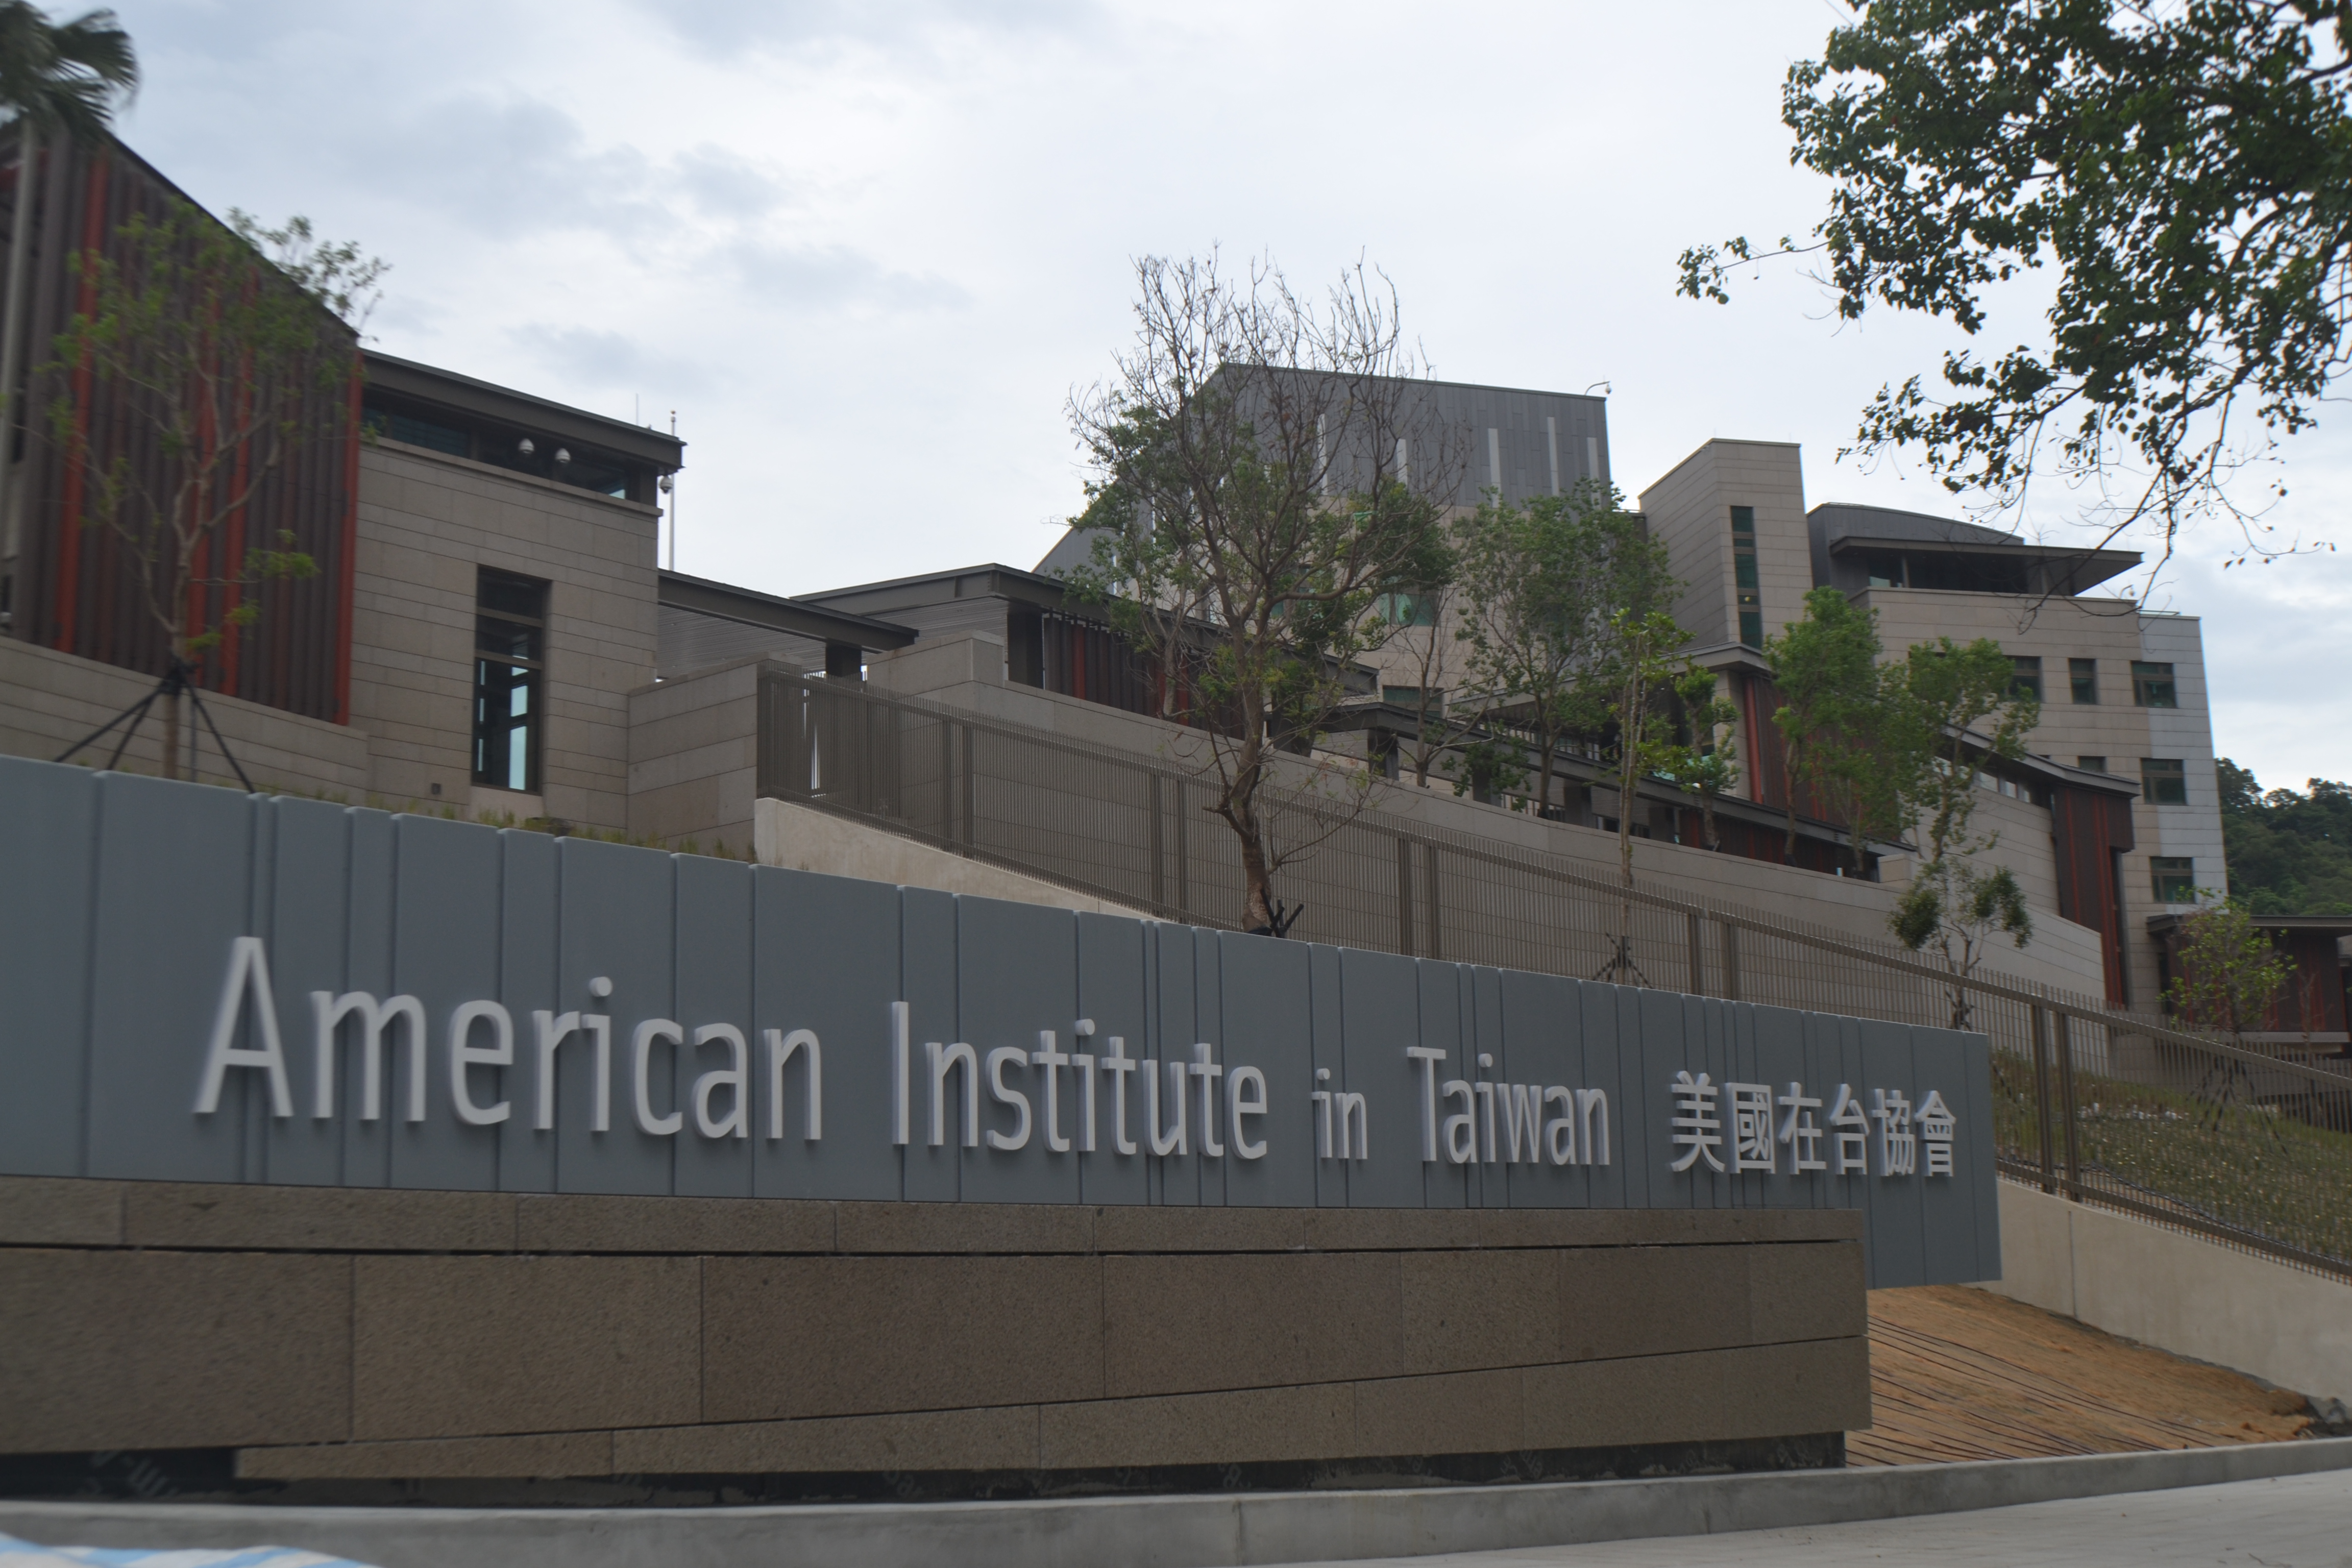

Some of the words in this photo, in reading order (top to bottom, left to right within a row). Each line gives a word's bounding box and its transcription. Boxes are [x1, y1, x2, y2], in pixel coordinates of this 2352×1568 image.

[192, 936, 822, 1140] American
[892, 1001, 1267, 1160] Institute
[1312, 1068, 1368, 1160] in
[1407, 1046, 1610, 1166] Taiwan
[1670, 1070, 1956, 1177] 美國在台協會
